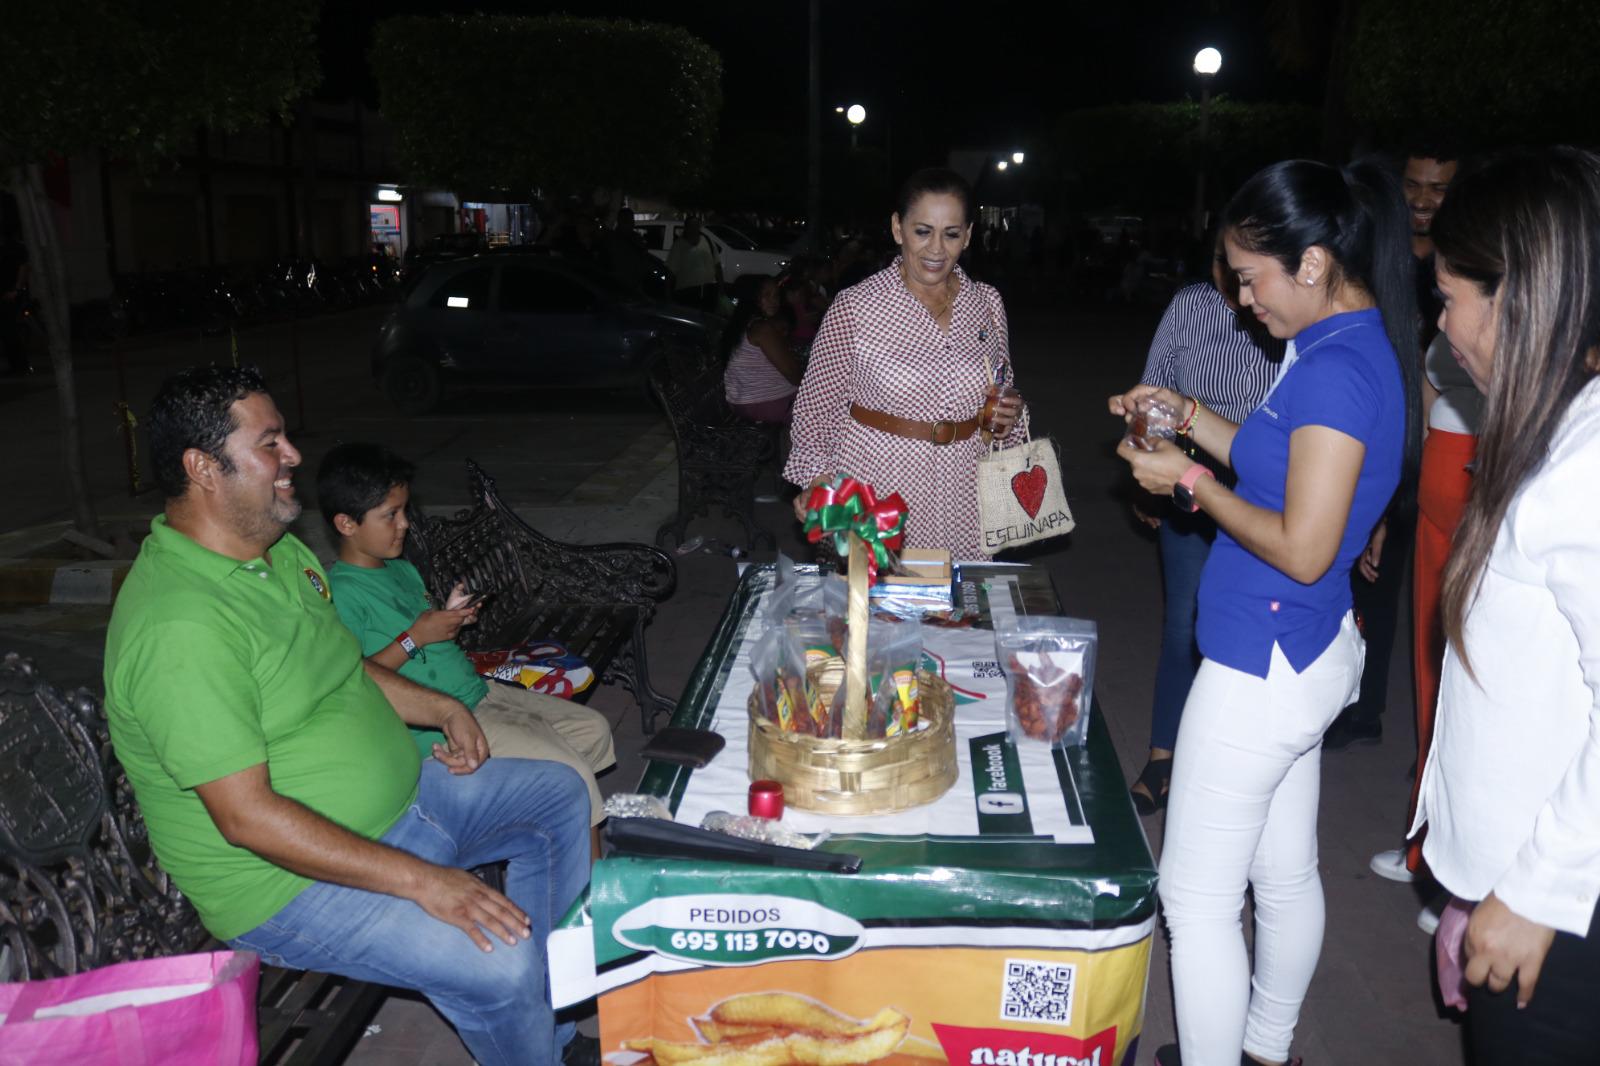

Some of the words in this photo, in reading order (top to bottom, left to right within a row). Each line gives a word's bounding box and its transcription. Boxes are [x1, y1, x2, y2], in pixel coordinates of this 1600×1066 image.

[982, 744, 1007, 791] facebook
[690, 908, 781, 925] PEDIDOS
[671, 930, 719, 951] 695
[724, 932, 759, 951] 113
[764, 930, 830, 954] 7090
